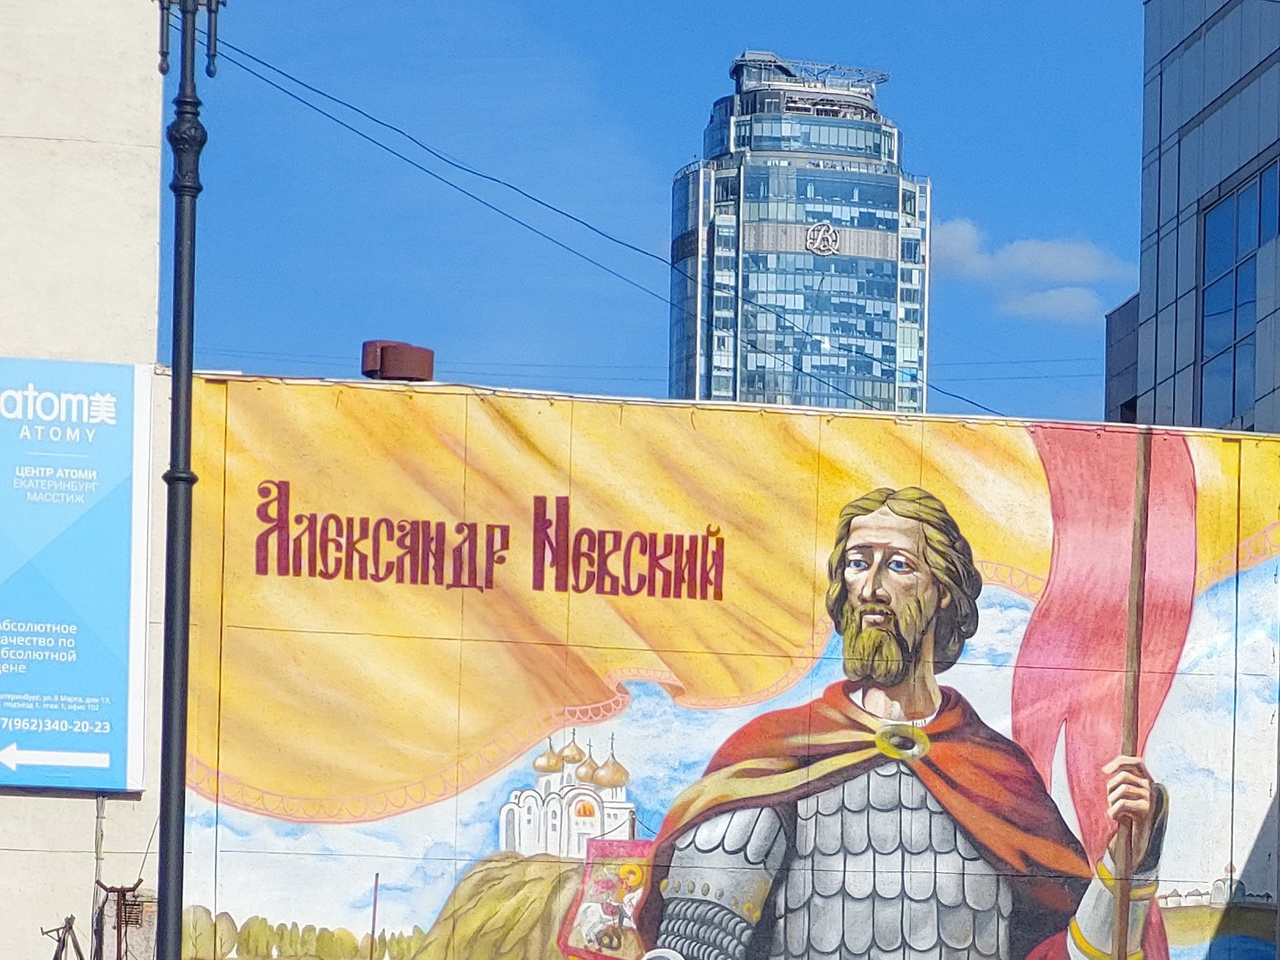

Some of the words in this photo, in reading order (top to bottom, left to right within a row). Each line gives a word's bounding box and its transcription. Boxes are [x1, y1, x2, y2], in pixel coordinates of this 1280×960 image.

[19, 424, 96, 443] ATOMY
[15, 466, 54, 478] ЦЕНТР
[56, 468, 97, 480] АТОМИ
[13, 478, 99, 492] ЕКАТЕРИНБУРГ
[26, 491, 85, 504] МАССТИЖ
[255, 479, 511, 593] Александр
[531, 494, 726, 601] Невский
[58, 638, 75, 647] по
[0, 663, 26, 675] ене
[1, 717, 111, 734] 7(962)340-20-23
